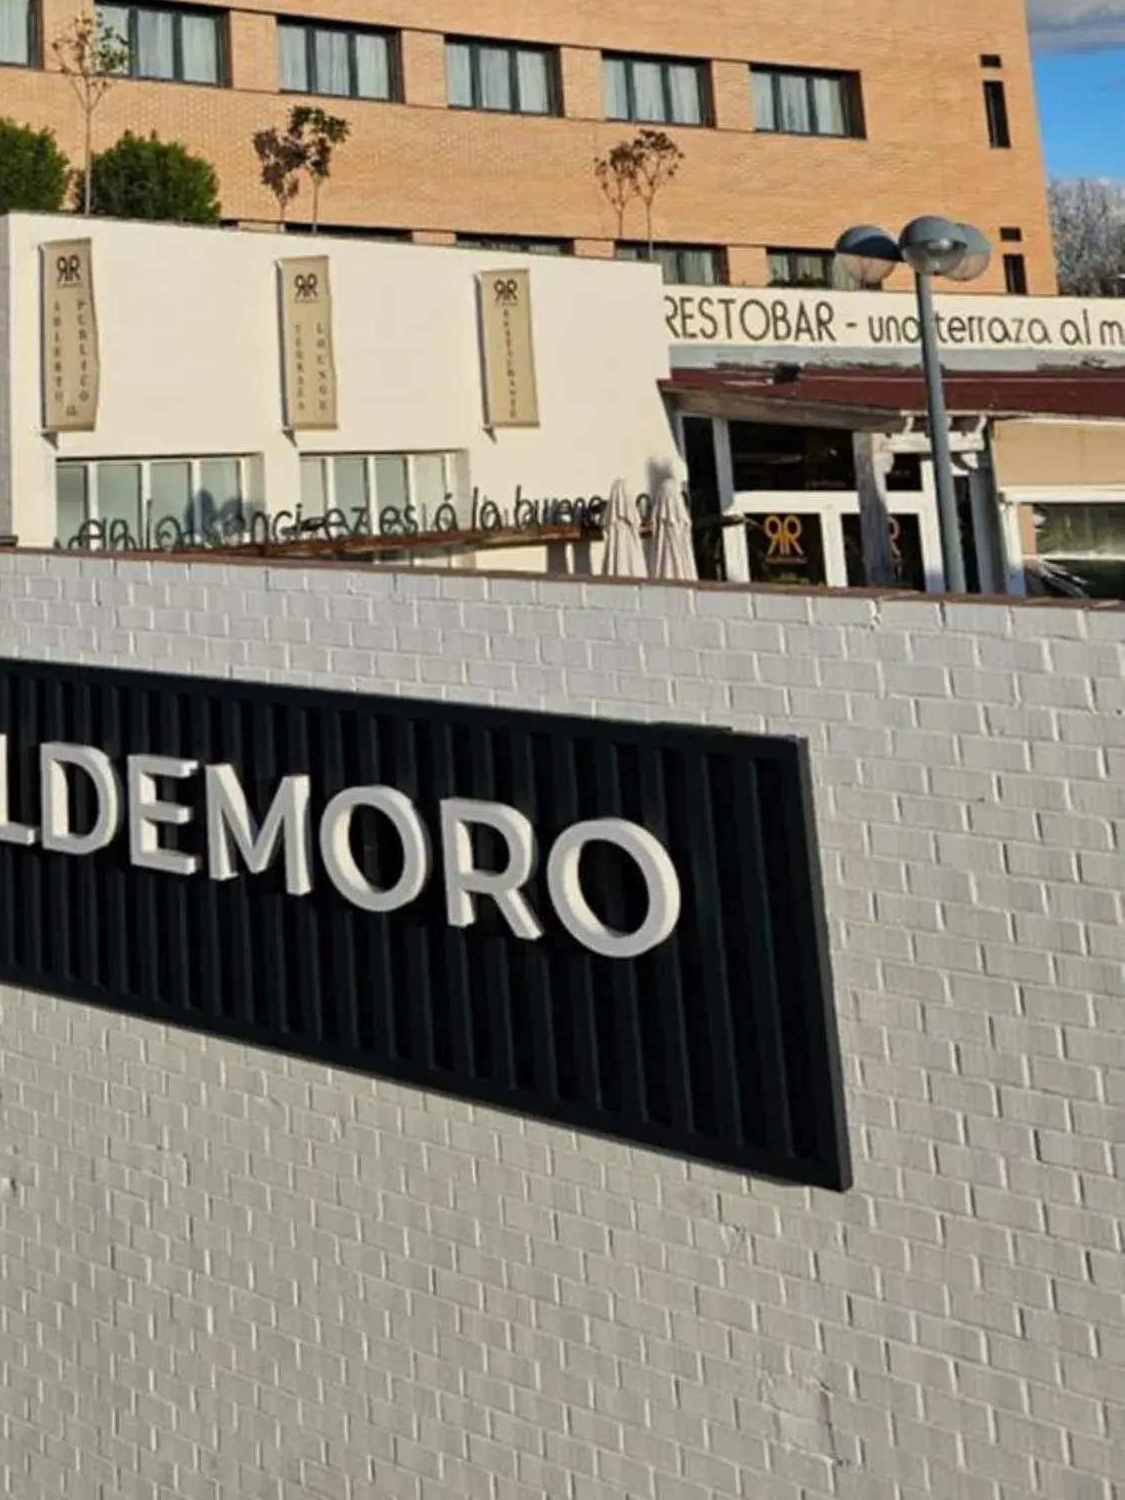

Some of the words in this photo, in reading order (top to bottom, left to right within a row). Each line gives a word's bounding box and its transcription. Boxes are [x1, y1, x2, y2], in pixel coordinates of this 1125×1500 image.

[663, 295, 837, 343] RESTOBAR
[934, 309, 1052, 344] terraza
[1060, 308, 1091, 346] al
